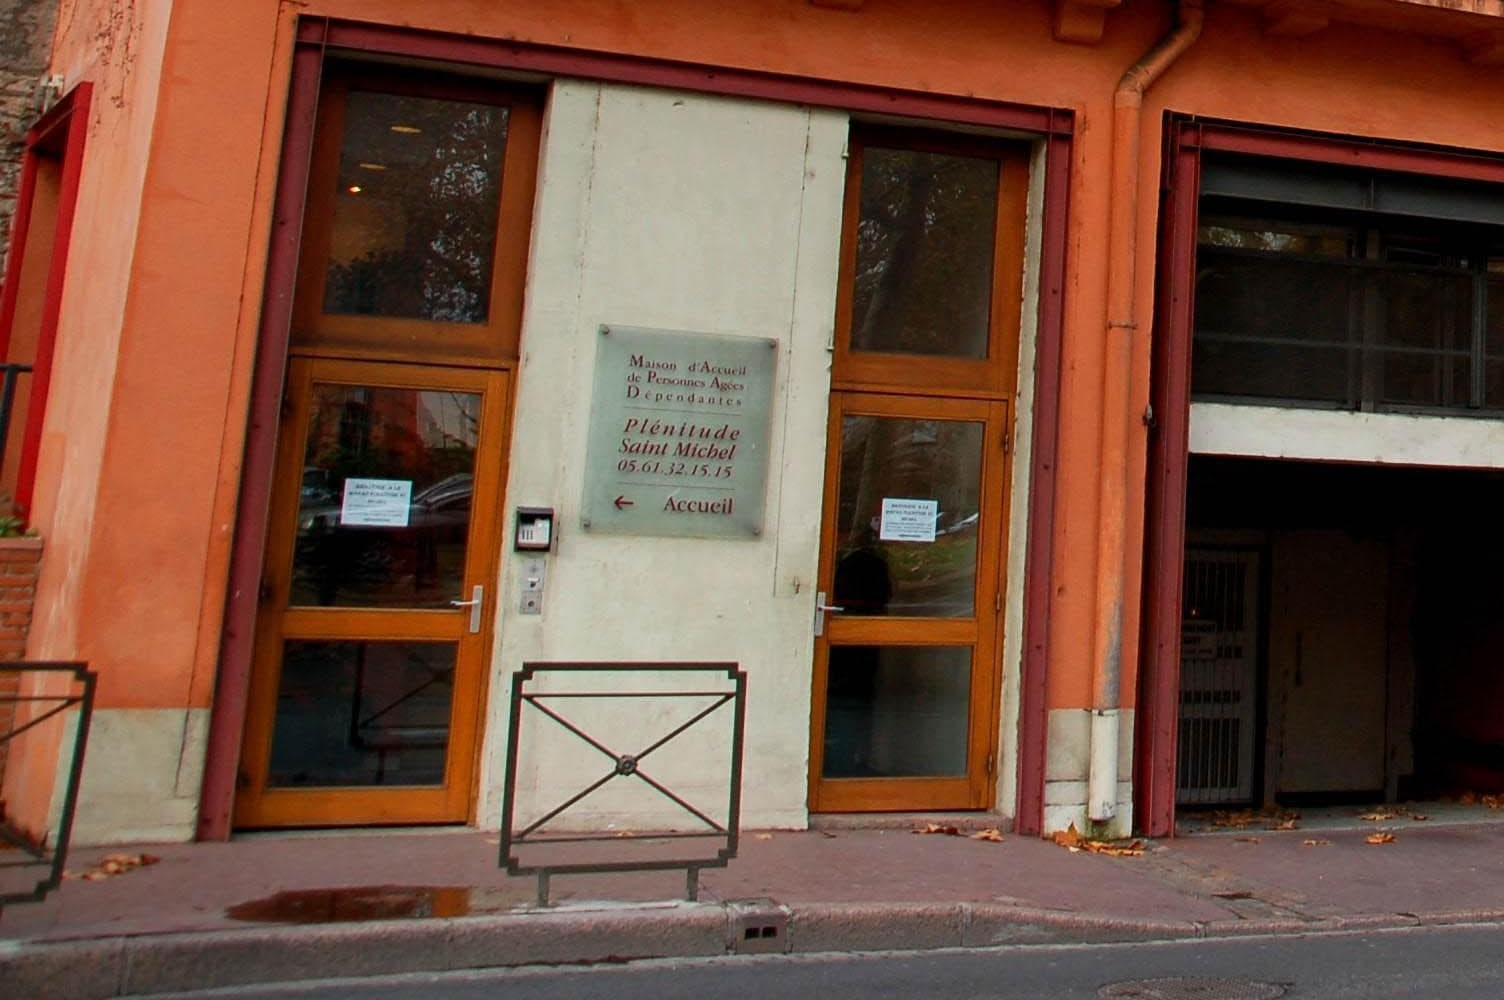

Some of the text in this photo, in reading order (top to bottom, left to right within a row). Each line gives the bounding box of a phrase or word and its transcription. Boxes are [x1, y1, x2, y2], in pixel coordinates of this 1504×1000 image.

[629, 354, 747, 377] Maison d'Accueil
[627, 371, 642, 383] de
[647, 370, 706, 389] Personnes
[627, 385, 742, 407] Dépendantes
[624, 418, 740, 441] Plénitude
[618, 438, 737, 461] Saint Michel
[617, 459, 733, 478] 05.61.32.15.15
[663, 495, 734, 516] Accueil
